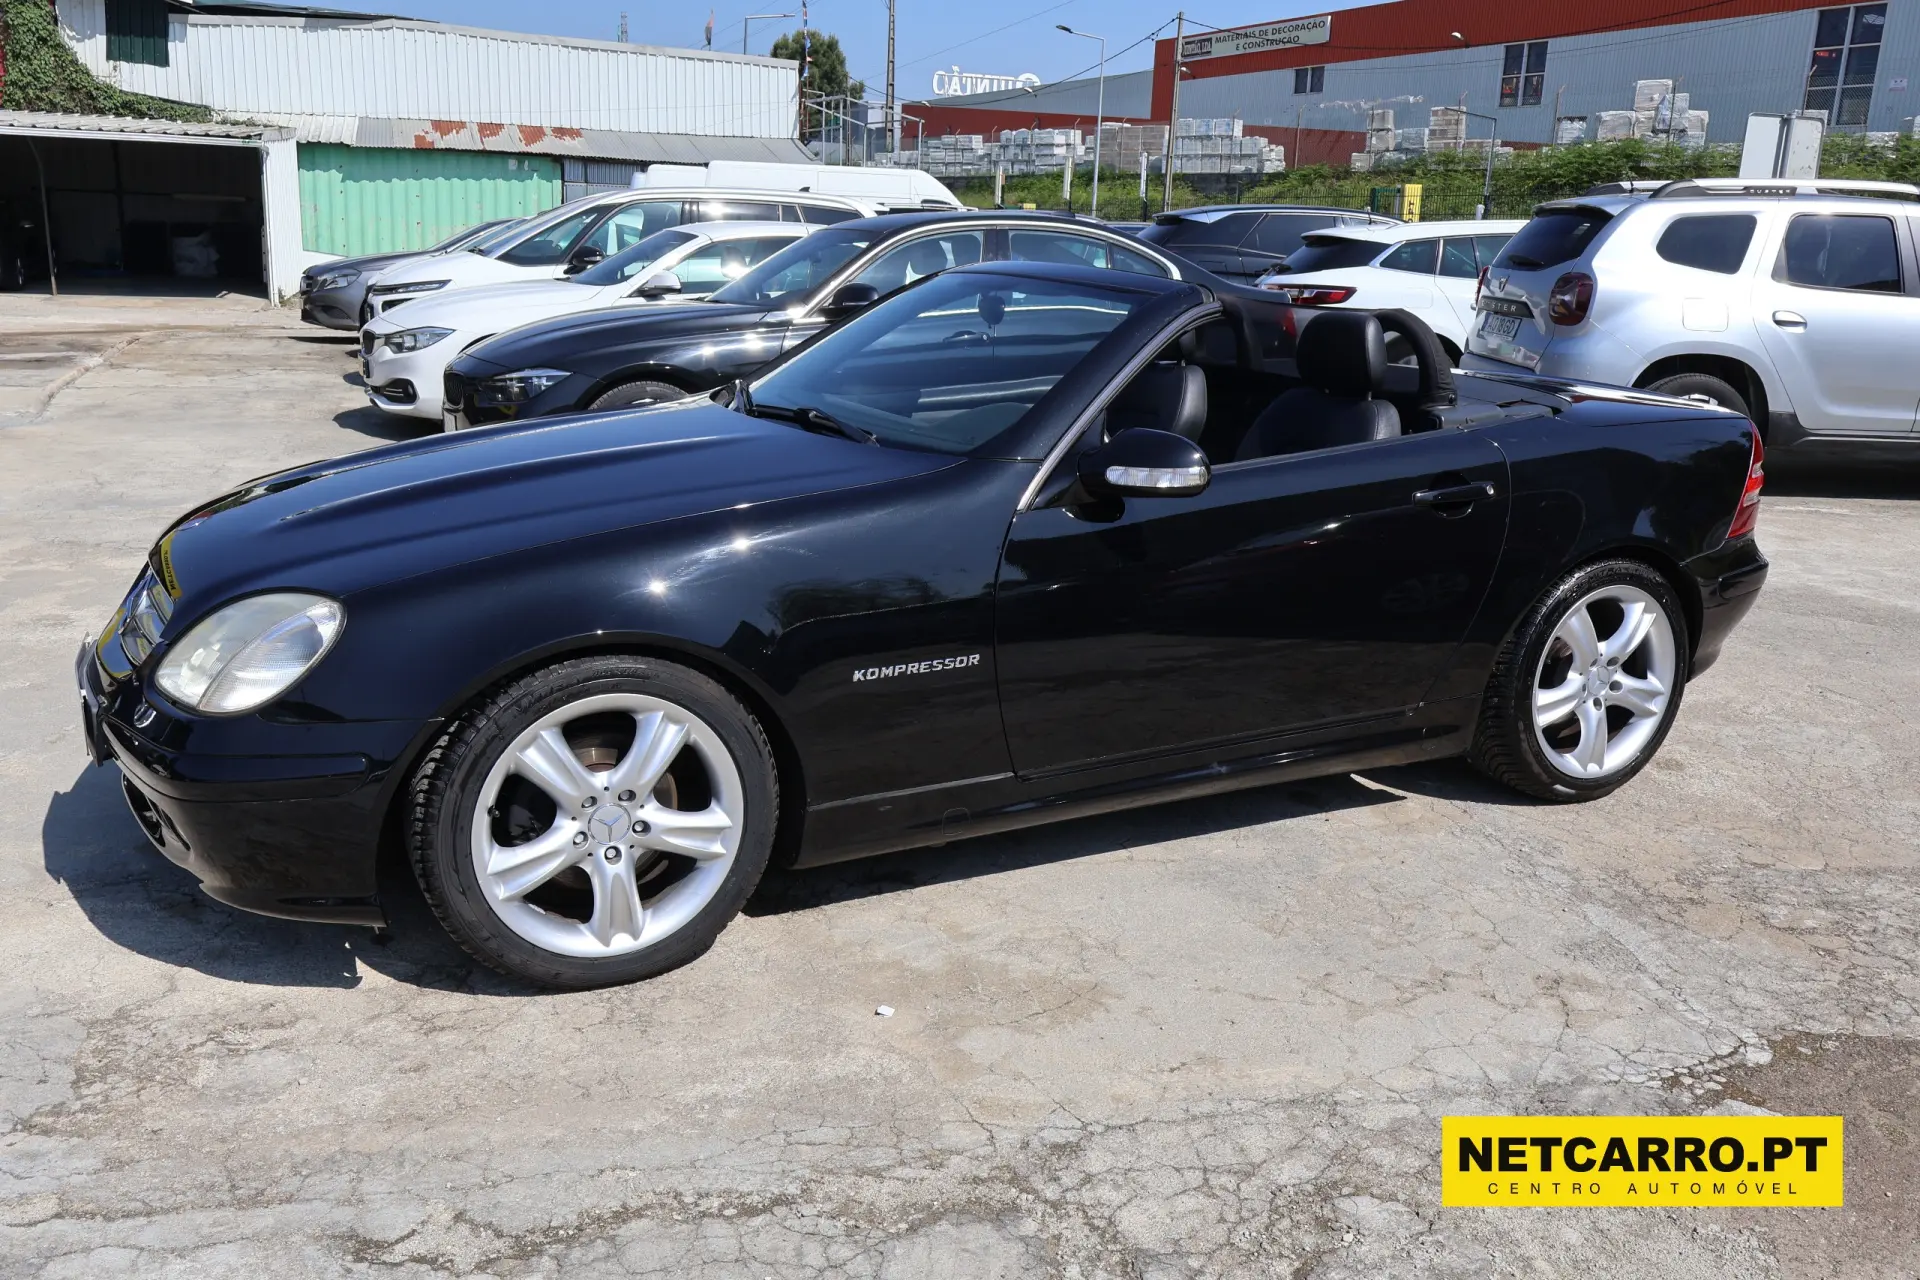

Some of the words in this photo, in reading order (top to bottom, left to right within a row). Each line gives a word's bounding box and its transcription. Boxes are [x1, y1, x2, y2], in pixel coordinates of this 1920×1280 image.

[1215, 29, 1256, 44] MATERIAIS
[1259, 28, 1269, 37] DE
[1272, 19, 1326, 35] DECORAÇÃO
[1236, 43, 1240, 51] E
[853, 653, 980, 682] KOMPRESSOR
